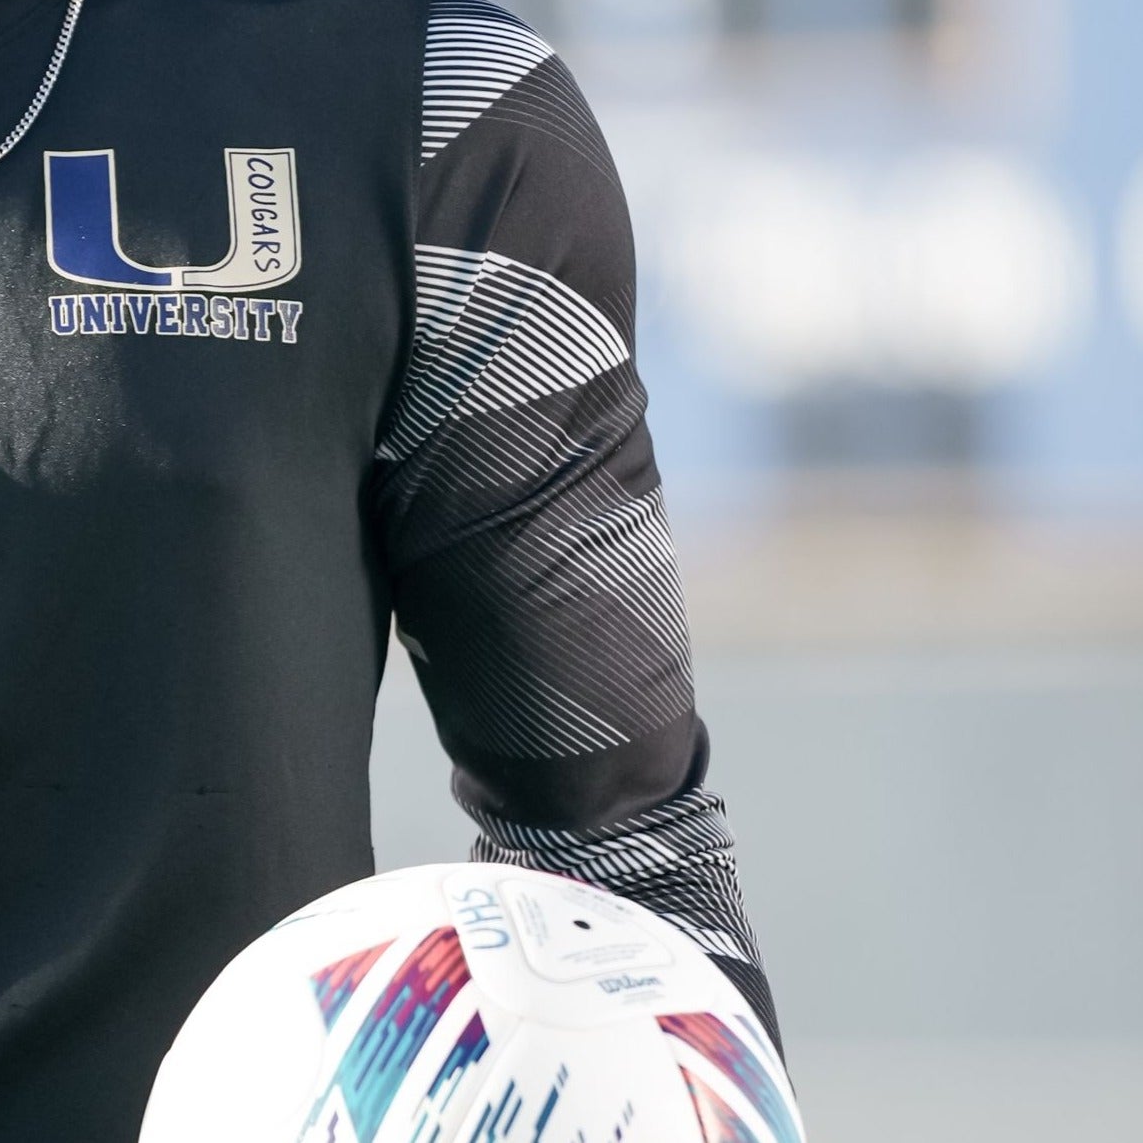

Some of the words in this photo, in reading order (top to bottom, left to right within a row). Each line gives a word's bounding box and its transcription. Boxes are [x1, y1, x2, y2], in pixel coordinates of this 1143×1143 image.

[246, 157, 282, 273] COUGARS
[48, 293, 303, 343] UNIVERSITY
[452, 888, 510, 950] UHS
[597, 974, 665, 994] Wilson
